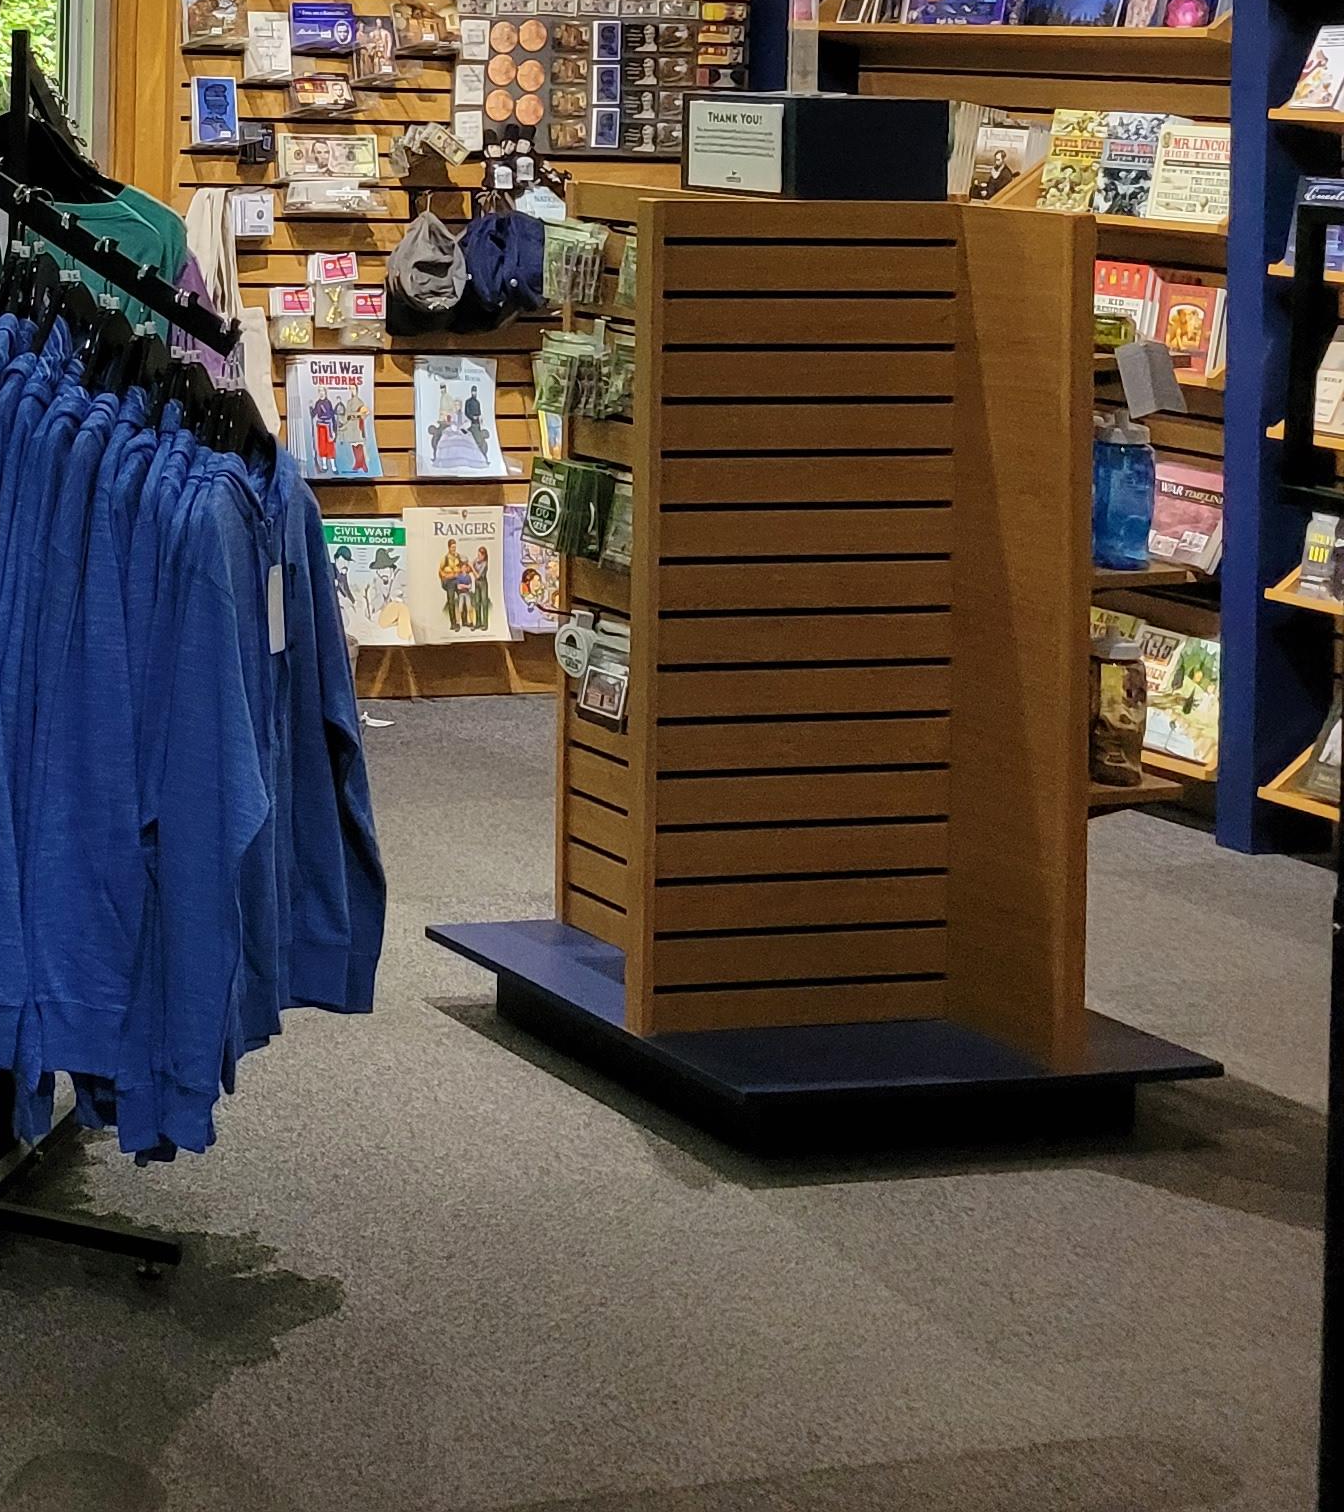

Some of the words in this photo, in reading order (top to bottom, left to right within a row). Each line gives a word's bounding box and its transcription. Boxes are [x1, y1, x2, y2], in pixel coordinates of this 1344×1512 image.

[708, 111, 737, 124] THANK
[740, 113, 762, 125] YOU!
[310, 360, 337, 374] Civil
[338, 361, 365, 375] War
[311, 375, 363, 386] UNIFORMS
[334, 526, 363, 537] CIVIL
[364, 527, 392, 537] WAR
[433, 520, 496, 536] RANGERS
